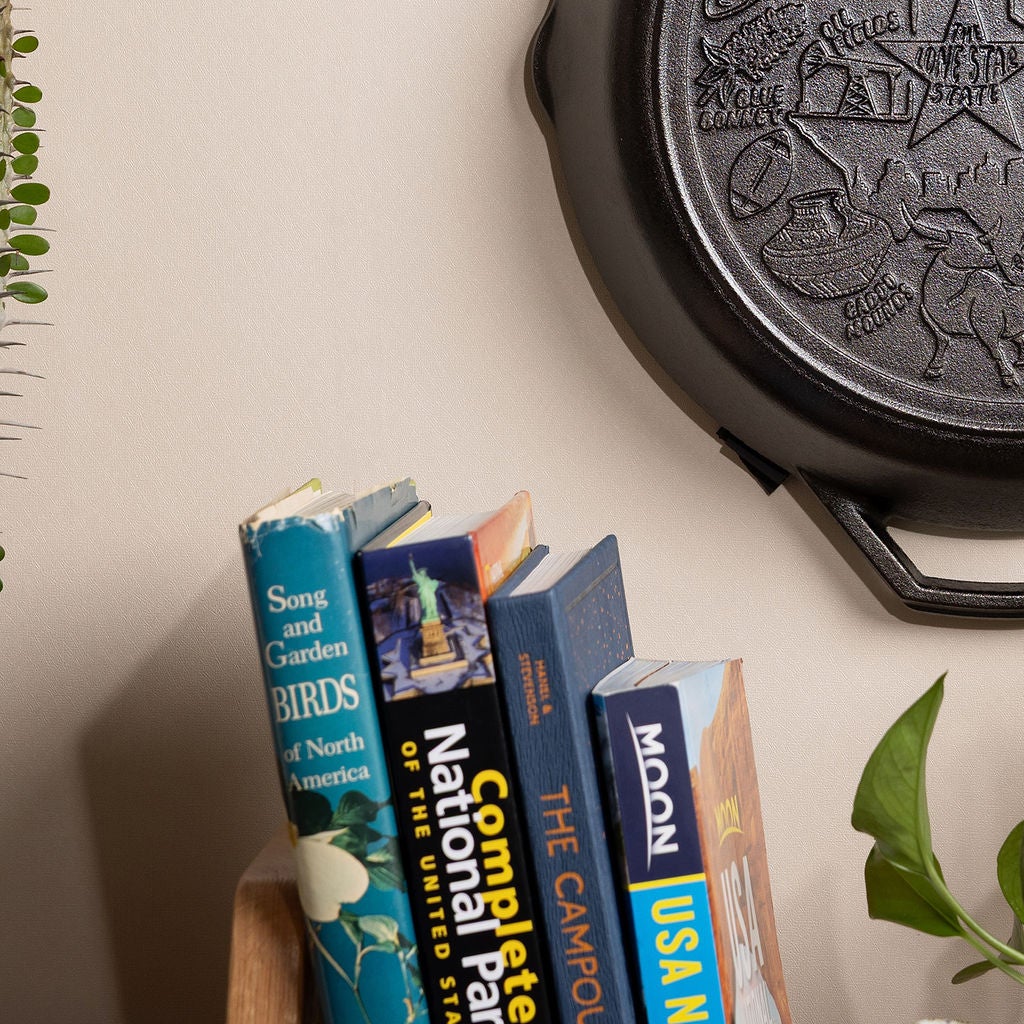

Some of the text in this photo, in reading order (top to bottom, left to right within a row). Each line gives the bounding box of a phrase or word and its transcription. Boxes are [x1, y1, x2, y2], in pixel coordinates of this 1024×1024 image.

[820, 8, 900, 57] OIL FIELDS
[915, 44, 1020, 84] LONE STAR
[929, 82, 999, 107] STATE
[267, 584, 328, 613] Song
[283, 612, 323, 638] and
[266, 640, 348, 669] Garden
[271, 673, 360, 723] BIRDS
[284, 732, 365, 763] of North
[401, 740, 420, 772] OF
[288, 765, 370, 792] America
[634, 723, 679, 856] MOON
[408, 787, 431, 839] THE
[423, 723, 501, 936] National
[540, 784, 580, 857] THE
[419, 854, 451, 960] UNITED
[471, 769, 539, 1024] Complete
[651, 895, 702, 986] USA
[720, 855, 764, 990] USA
